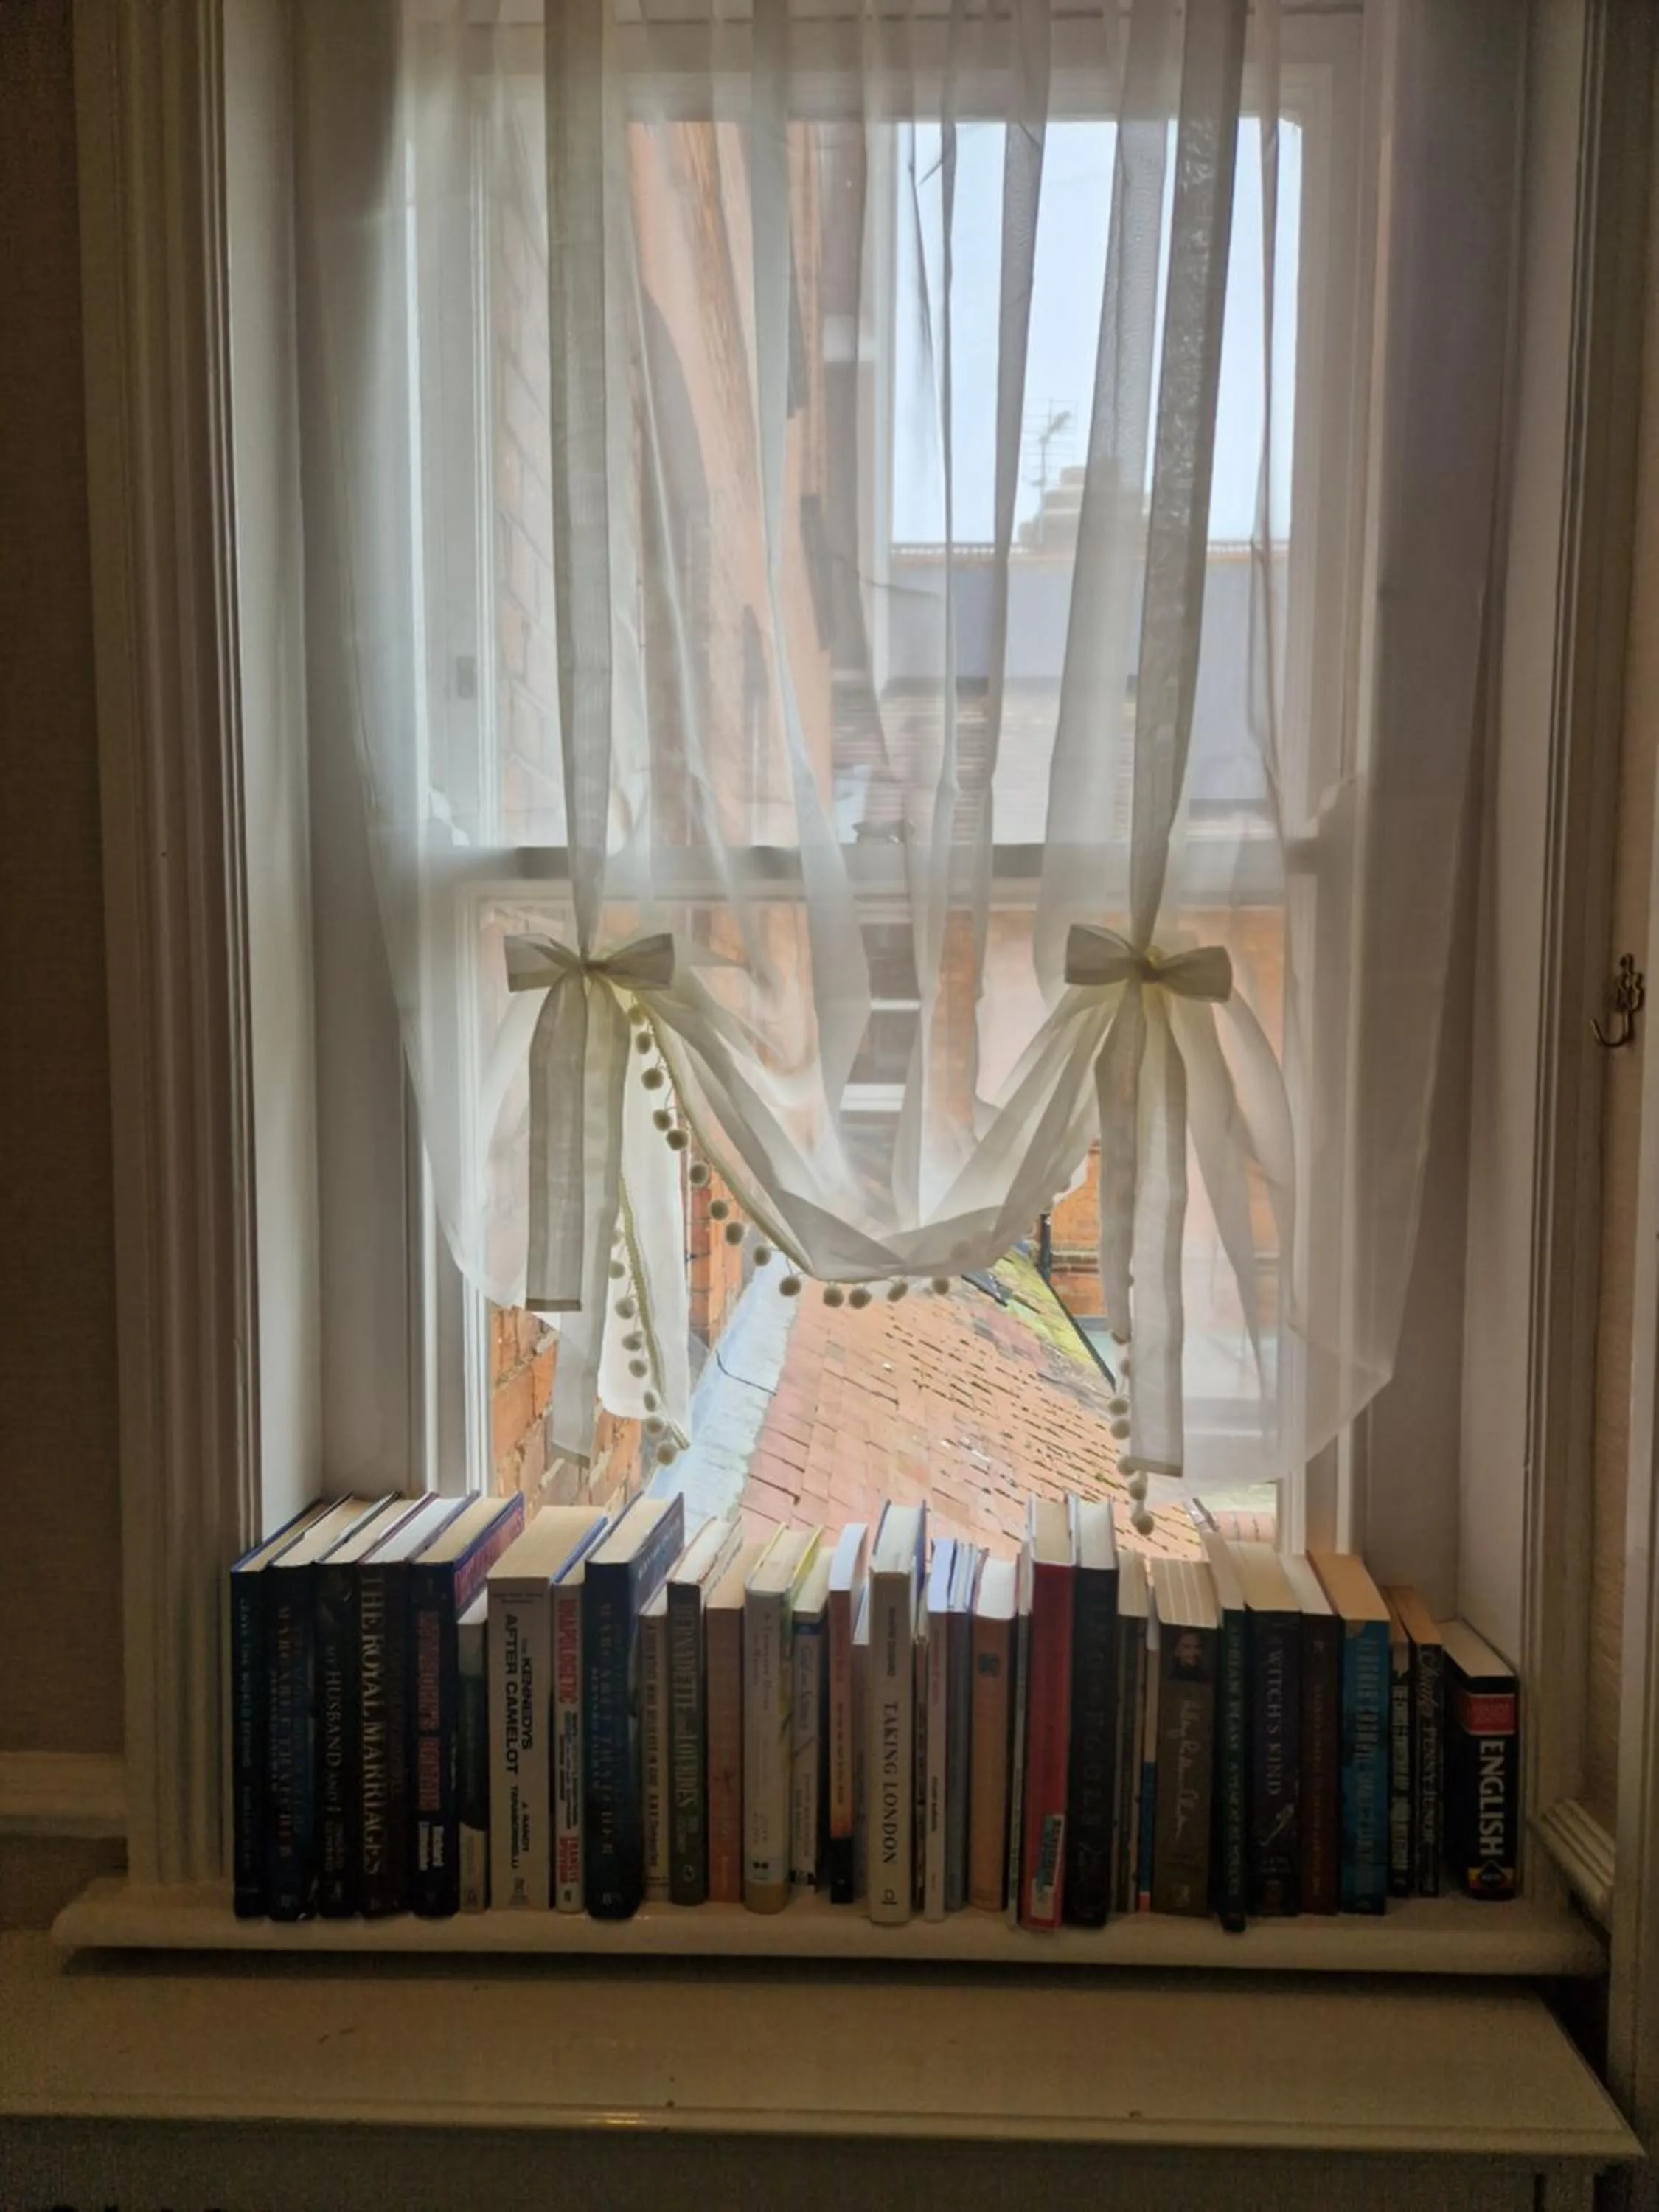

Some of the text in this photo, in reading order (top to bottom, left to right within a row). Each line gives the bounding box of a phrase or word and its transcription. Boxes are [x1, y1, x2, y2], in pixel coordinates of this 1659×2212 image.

[505, 1614, 519, 1775] AFTER CAMELOT
[558, 1599, 579, 1704] UNAPOLOGETIC
[672, 1604, 698, 1711] BERNADETTE
[1228, 1623, 1242, 1694] ADRIAN
[1265, 1649, 1284, 1734] WITCH'S
[325, 1669, 342, 1767] HUSBAND
[361, 1576, 386, 1874] THE ROYAL MARRIAGES
[521, 1657, 533, 1750] KENNEDYS
[327, 1772, 338, 1802] AND
[674, 1735, 698, 1807] LOURDES
[883, 1700, 899, 1864] TAKING LONDON
[1265, 1742, 1284, 1795] KIND
[1422, 1727, 1439, 1844] PENNY JUNOR
[1478, 1739, 1506, 1857] ENGLISH
